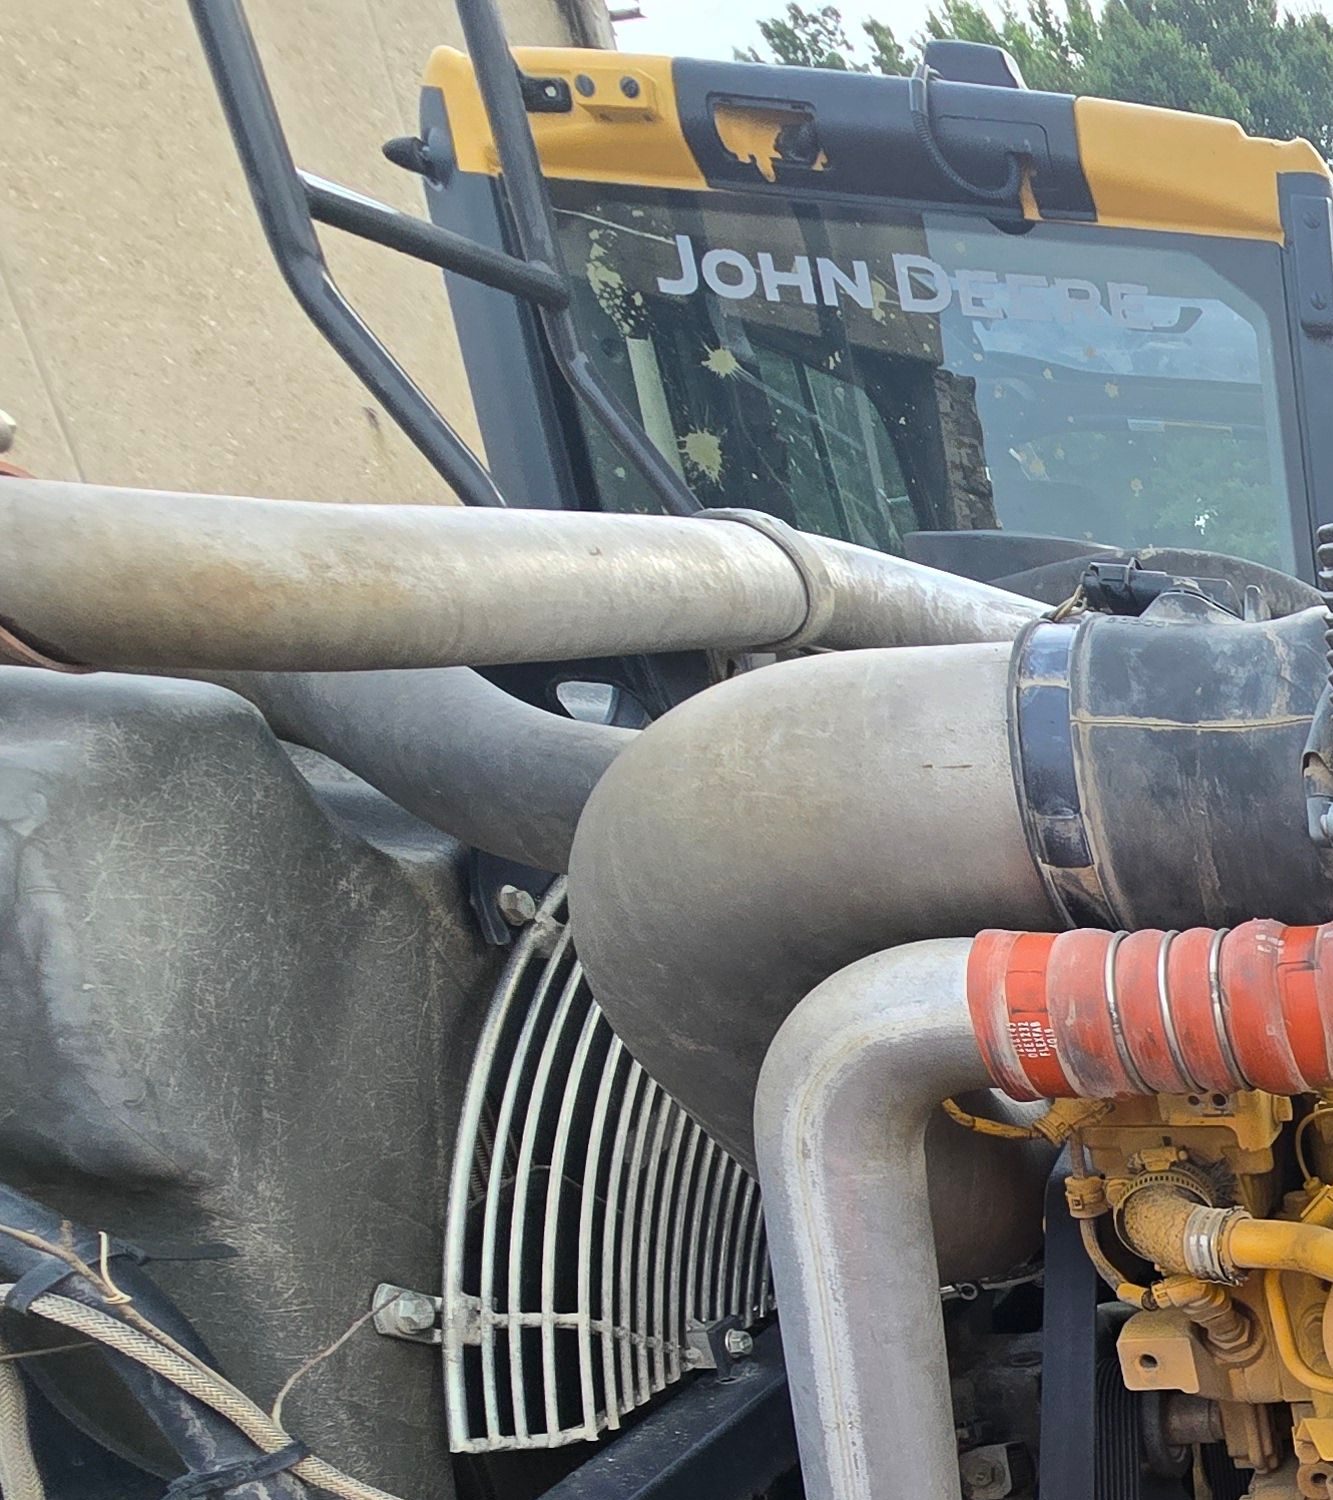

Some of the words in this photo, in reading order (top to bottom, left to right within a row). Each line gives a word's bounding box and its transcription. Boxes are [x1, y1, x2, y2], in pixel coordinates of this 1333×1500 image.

[658, 234, 876, 309] JOHN
[892, 252, 1156, 331] DEERE
[1030, 1021, 1051, 1057] FLEXFAB
